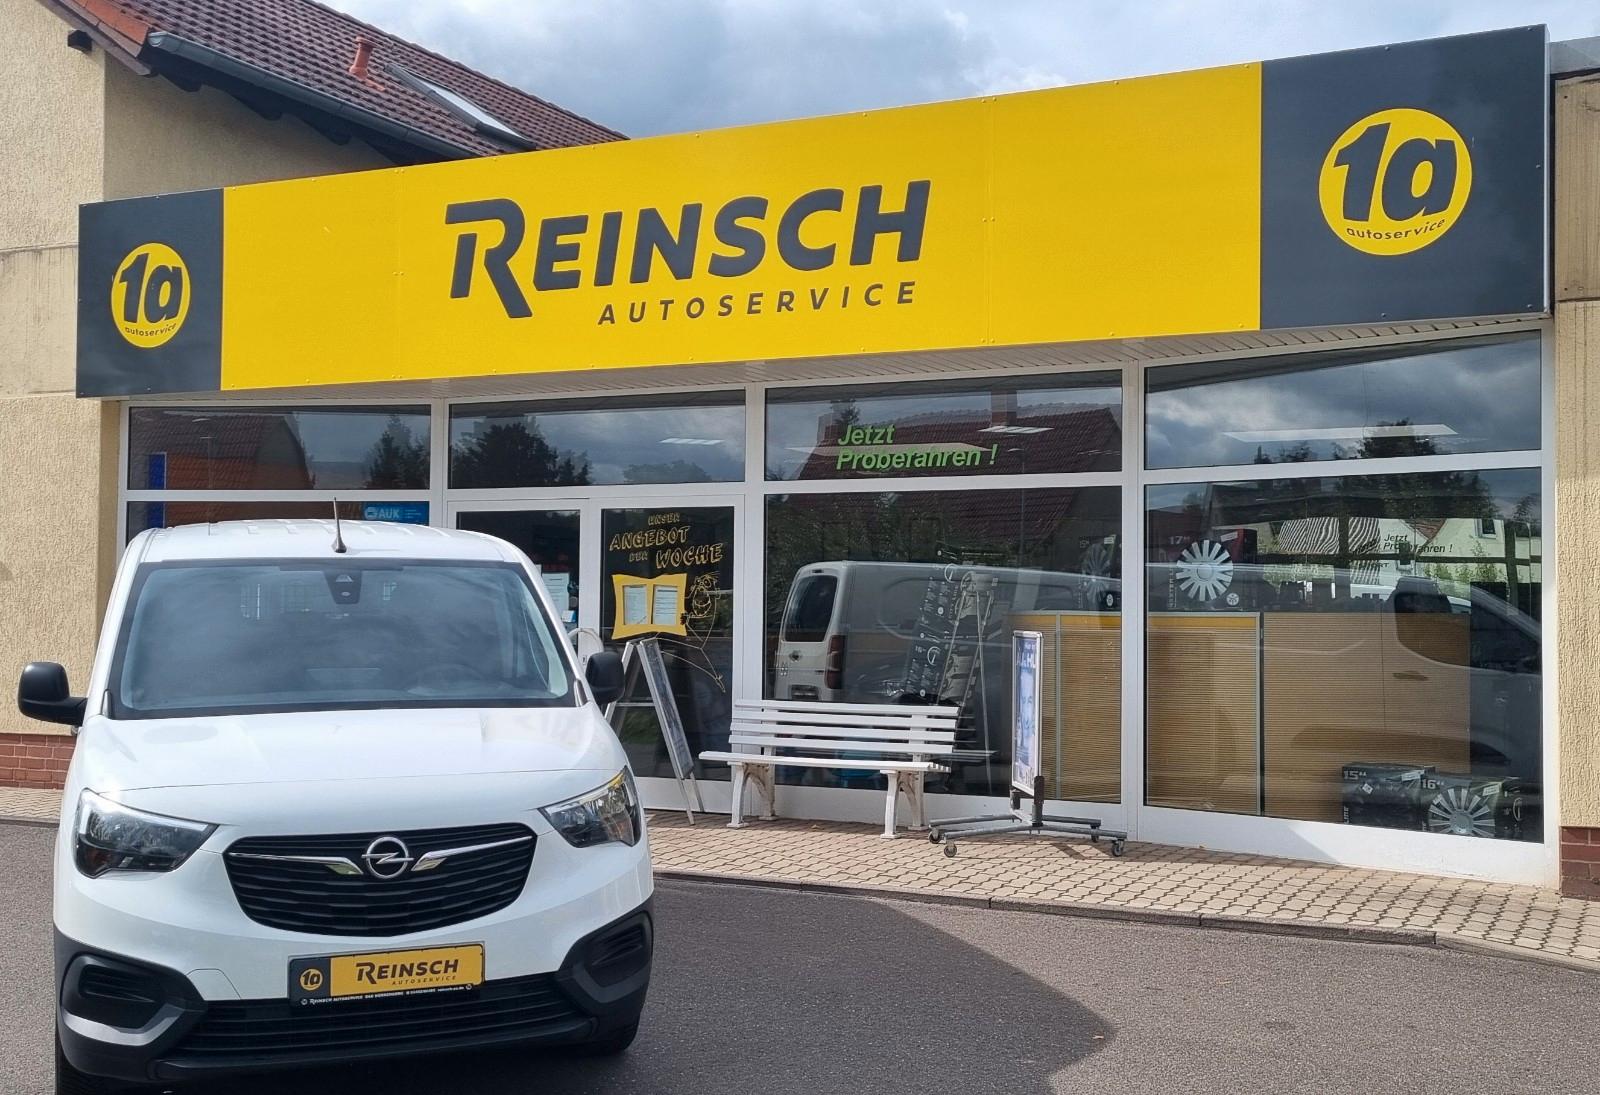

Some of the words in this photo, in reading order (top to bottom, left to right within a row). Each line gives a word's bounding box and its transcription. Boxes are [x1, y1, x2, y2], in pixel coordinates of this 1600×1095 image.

[1333, 122, 1458, 222] 1a
[1346, 218, 1446, 240] autoservice
[445, 179, 931, 319] REINSCH
[119, 252, 183, 324] 1a
[597, 281, 916, 326] AUTOSERVICE
[837, 423, 895, 446] Jetzt
[989, 443, 999, 465] !
[609, 525, 691, 551] ANGEBOT
[1383, 534, 1408, 542] Jetzt
[656, 542, 724, 569] WOCHE
[355, 958, 459, 985] REINSCH
[391, 975, 457, 986] AUTOSERVICE
